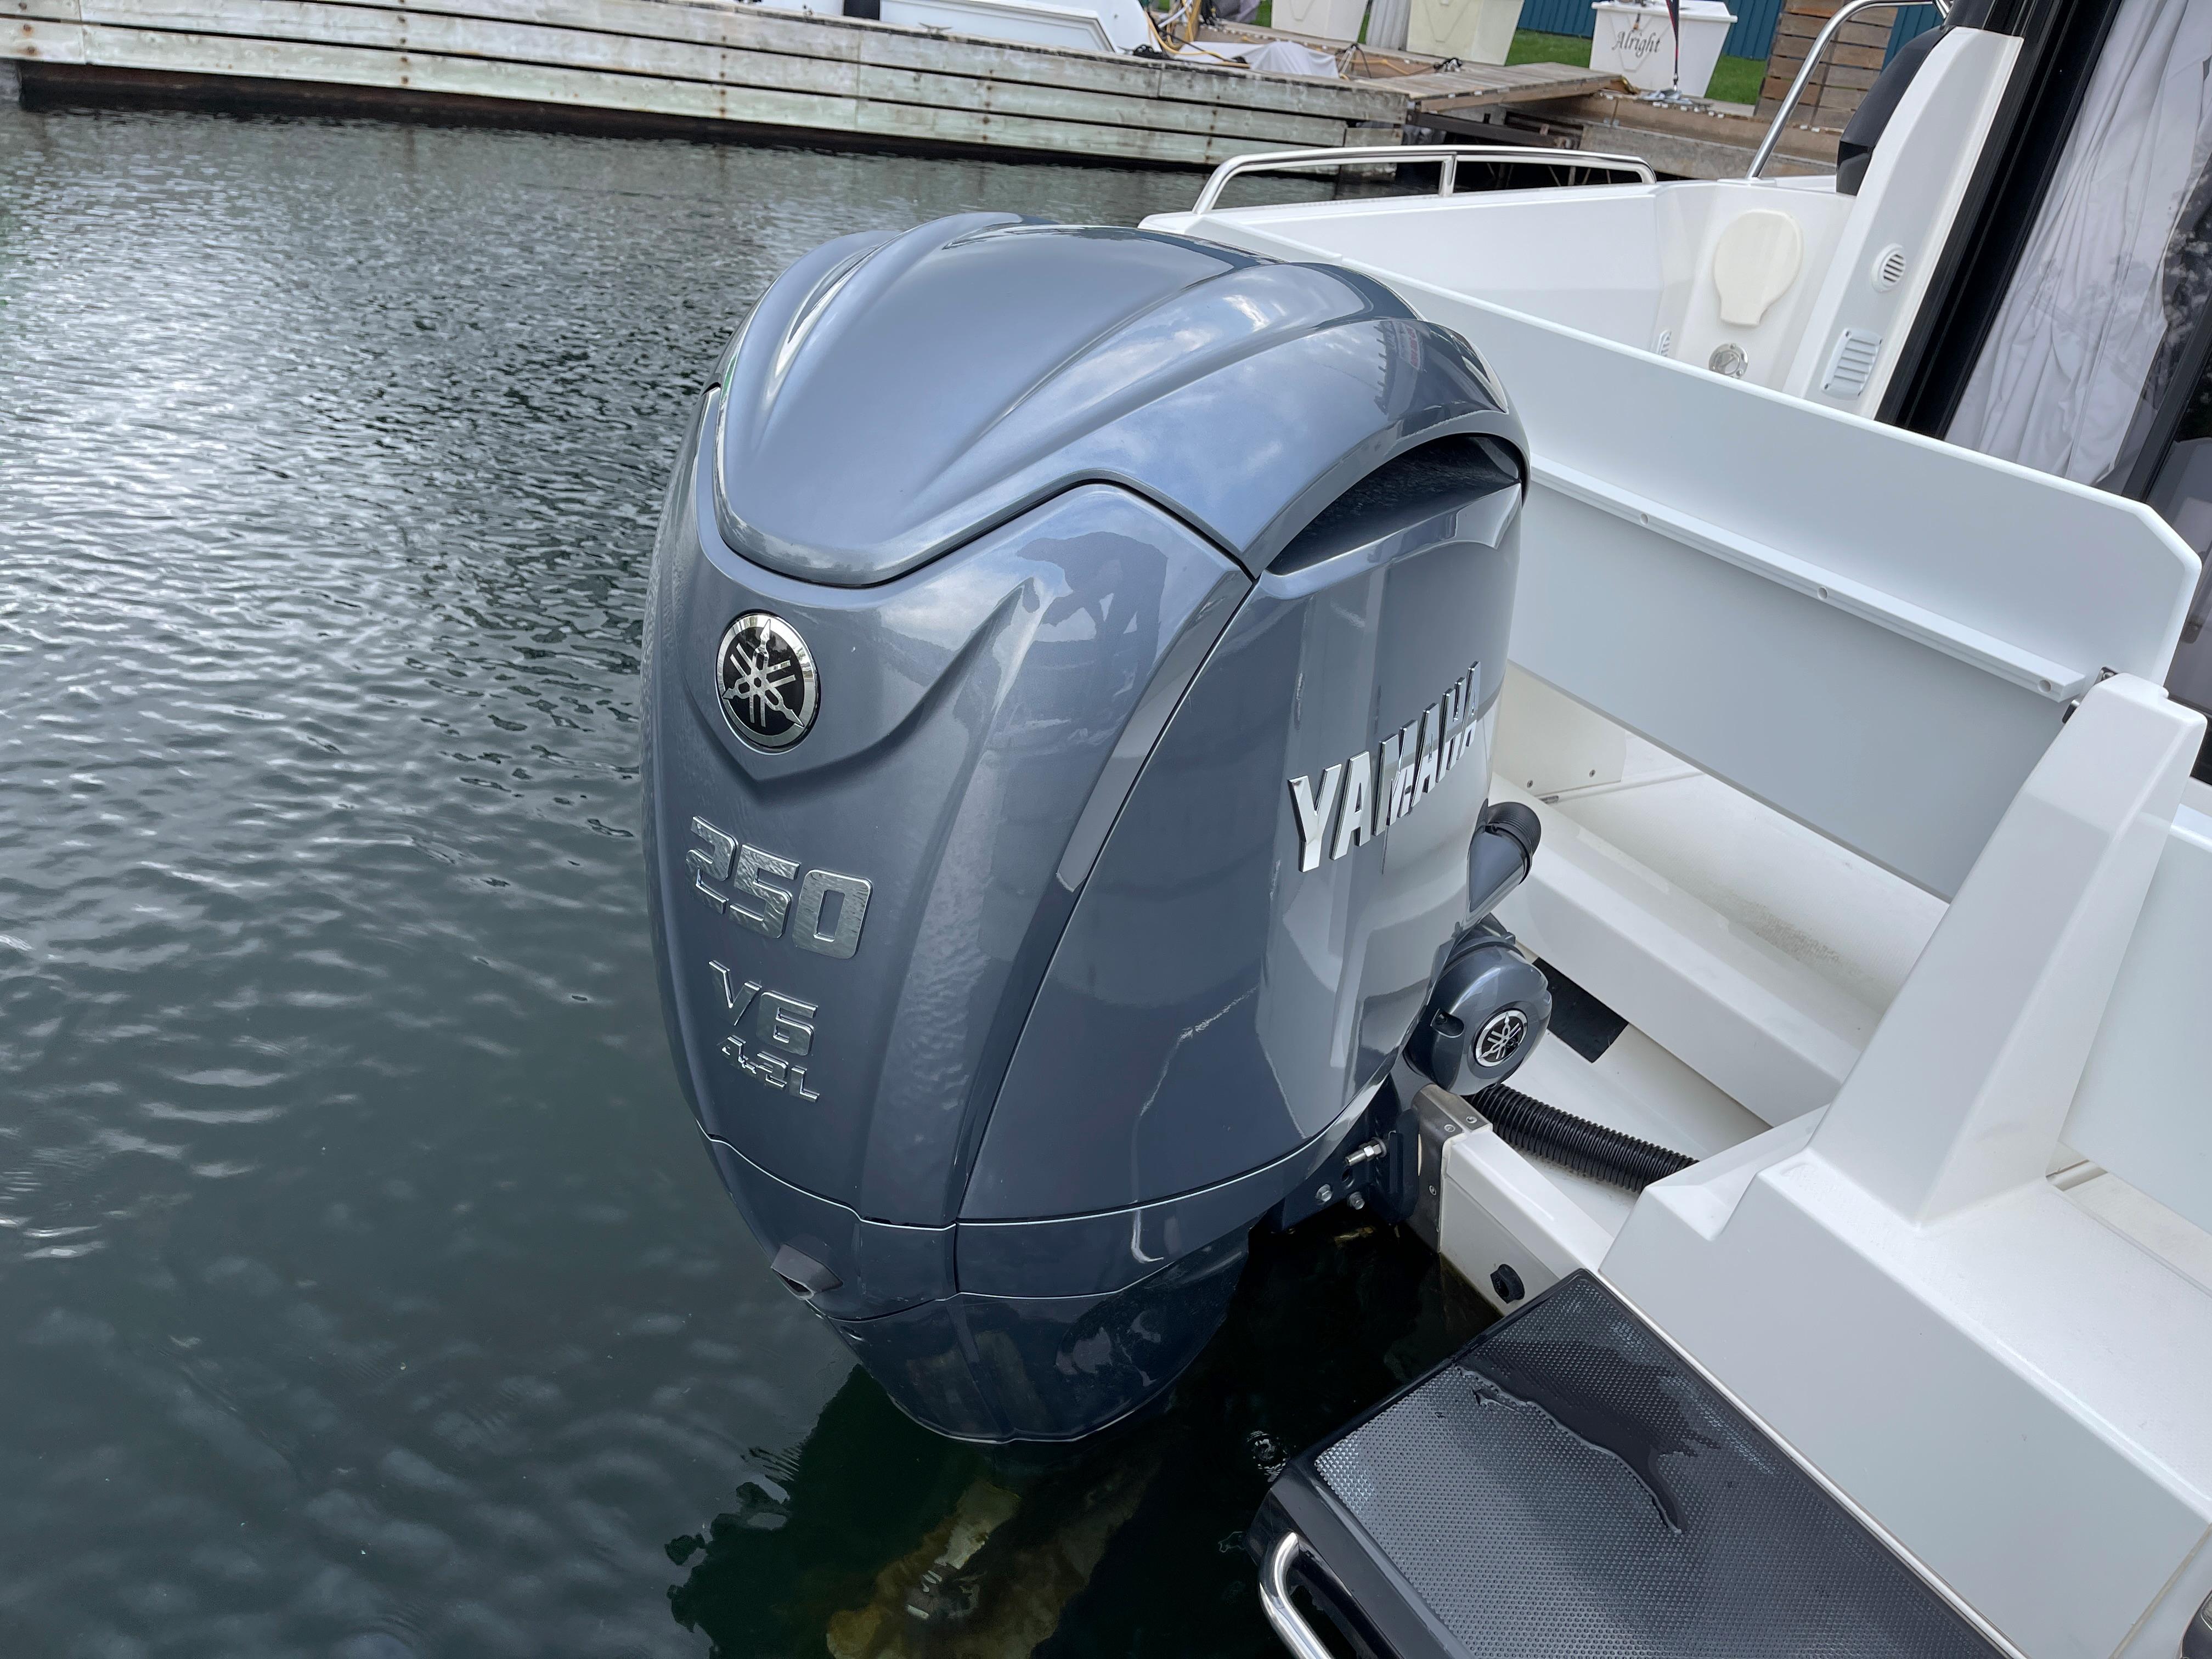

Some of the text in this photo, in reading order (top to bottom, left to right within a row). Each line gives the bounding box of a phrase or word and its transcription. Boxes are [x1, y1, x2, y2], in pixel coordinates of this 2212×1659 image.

[1611, 30, 1660, 58] Alright
[1288, 661, 1481, 872] YAMAHA
[686, 815, 873, 959] 250
[709, 961, 818, 1056] V6
